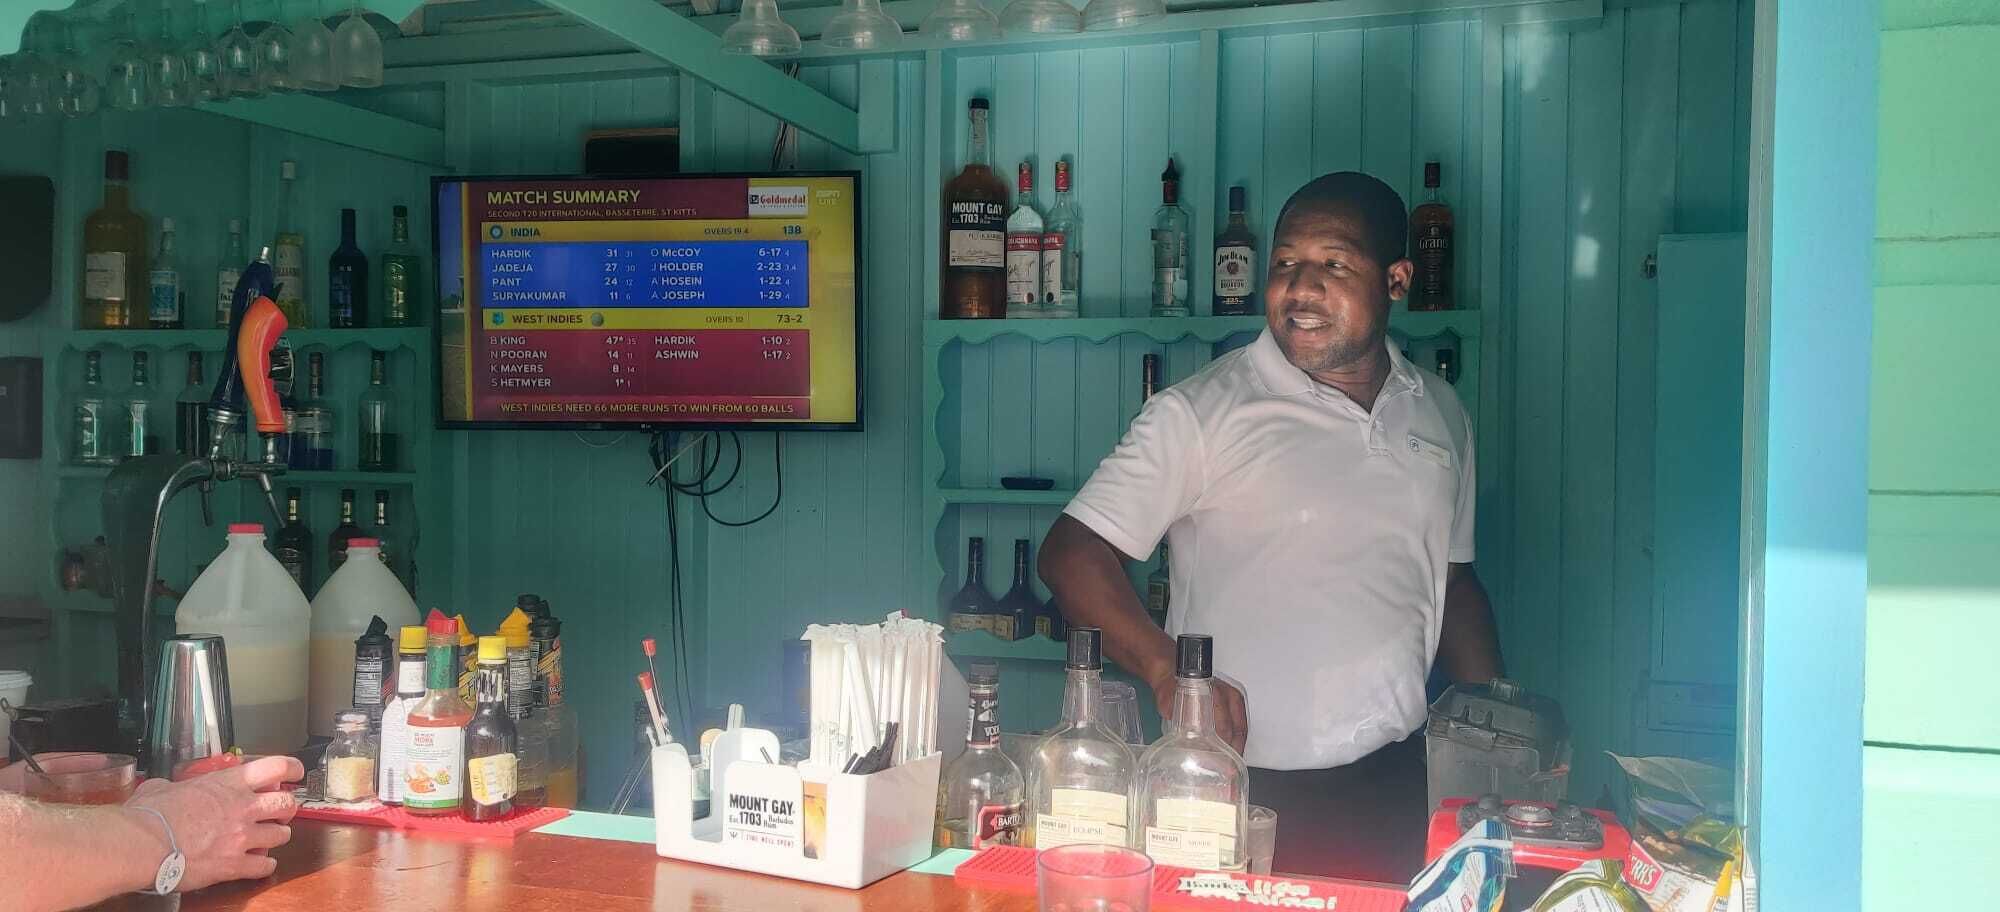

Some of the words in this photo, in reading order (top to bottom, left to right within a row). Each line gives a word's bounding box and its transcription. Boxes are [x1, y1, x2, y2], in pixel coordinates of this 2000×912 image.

[487, 190, 547, 205] MATCH
[553, 190, 641, 204] SUMMARY
[761, 195, 806, 205] Goldmedal
[488, 209, 520, 217] SECOND
[661, 207, 672, 216] ST
[673, 207, 697, 217] KITTS
[952, 202, 985, 213] MOUNT
[986, 203, 1003, 215] GAY
[960, 213, 979, 224] 1703
[510, 227, 542, 237] INDIA
[704, 227, 732, 235] OVERS
[783, 225, 802, 235] 138
[491, 249, 532, 258] HARDIK
[606, 249, 618, 257] 31
[650, 249, 659, 257] O
[662, 248, 701, 257] McCOY
[758, 248, 782, 257] 6-17
[492, 264, 534, 272] JADEJA
[604, 263, 617, 272] 27
[651, 263, 657, 272] J
[659, 262, 704, 271] HOLDER
[756, 262, 782, 271] 2-23
[492, 278, 522, 287] PANT
[604, 277, 618, 286] 24
[651, 277, 659, 285] A
[661, 276, 702, 286] HOSEIN
[759, 276, 782, 285] 1-22
[492, 291, 566, 301] SURYAKUMAR
[609, 292, 618, 300] 11
[651, 291, 659, 299] A
[662, 290, 705, 300] JOSEPH
[759, 291, 782, 300] 1-29
[512, 315, 544, 324] WEST
[547, 314, 583, 324] INDIES
[705, 316, 734, 324] OVERS
[776, 314, 803, 324] 73-2
[490, 336, 498, 345] B
[500, 336, 526, 345] KING
[655, 336, 696, 345] HARDIK
[761, 336, 783, 345] 1-10
[490, 351, 499, 359] N
[500, 350, 547, 359] POORAN
[607, 351, 619, 359] 14
[655, 350, 699, 360] ASHWIN
[762, 351, 783, 360] 1-17
[490, 365, 499, 373] K
[500, 364, 544, 373] MAYERS
[612, 365, 619, 373] 8
[491, 379, 498, 387] S
[500, 378, 551, 387] HETMYER
[501, 404, 530, 413] WEST
[531, 403, 562, 413] INDIES
[565, 403, 592, 413] NEED
[594, 404, 608, 412] 66
[608, 403, 641, 413] MORE
[642, 404, 669, 414] RUNS
[672, 404, 687, 413] TO
[690, 404, 710, 413] WIN
[712, 404, 743, 413] FROM
[745, 404, 759, 412] 60
[761, 404, 794, 413] BALLS
[729, 793, 769, 813] MOUNT
[771, 799, 794, 816] GAY
[740, 811, 762, 827] 1703
